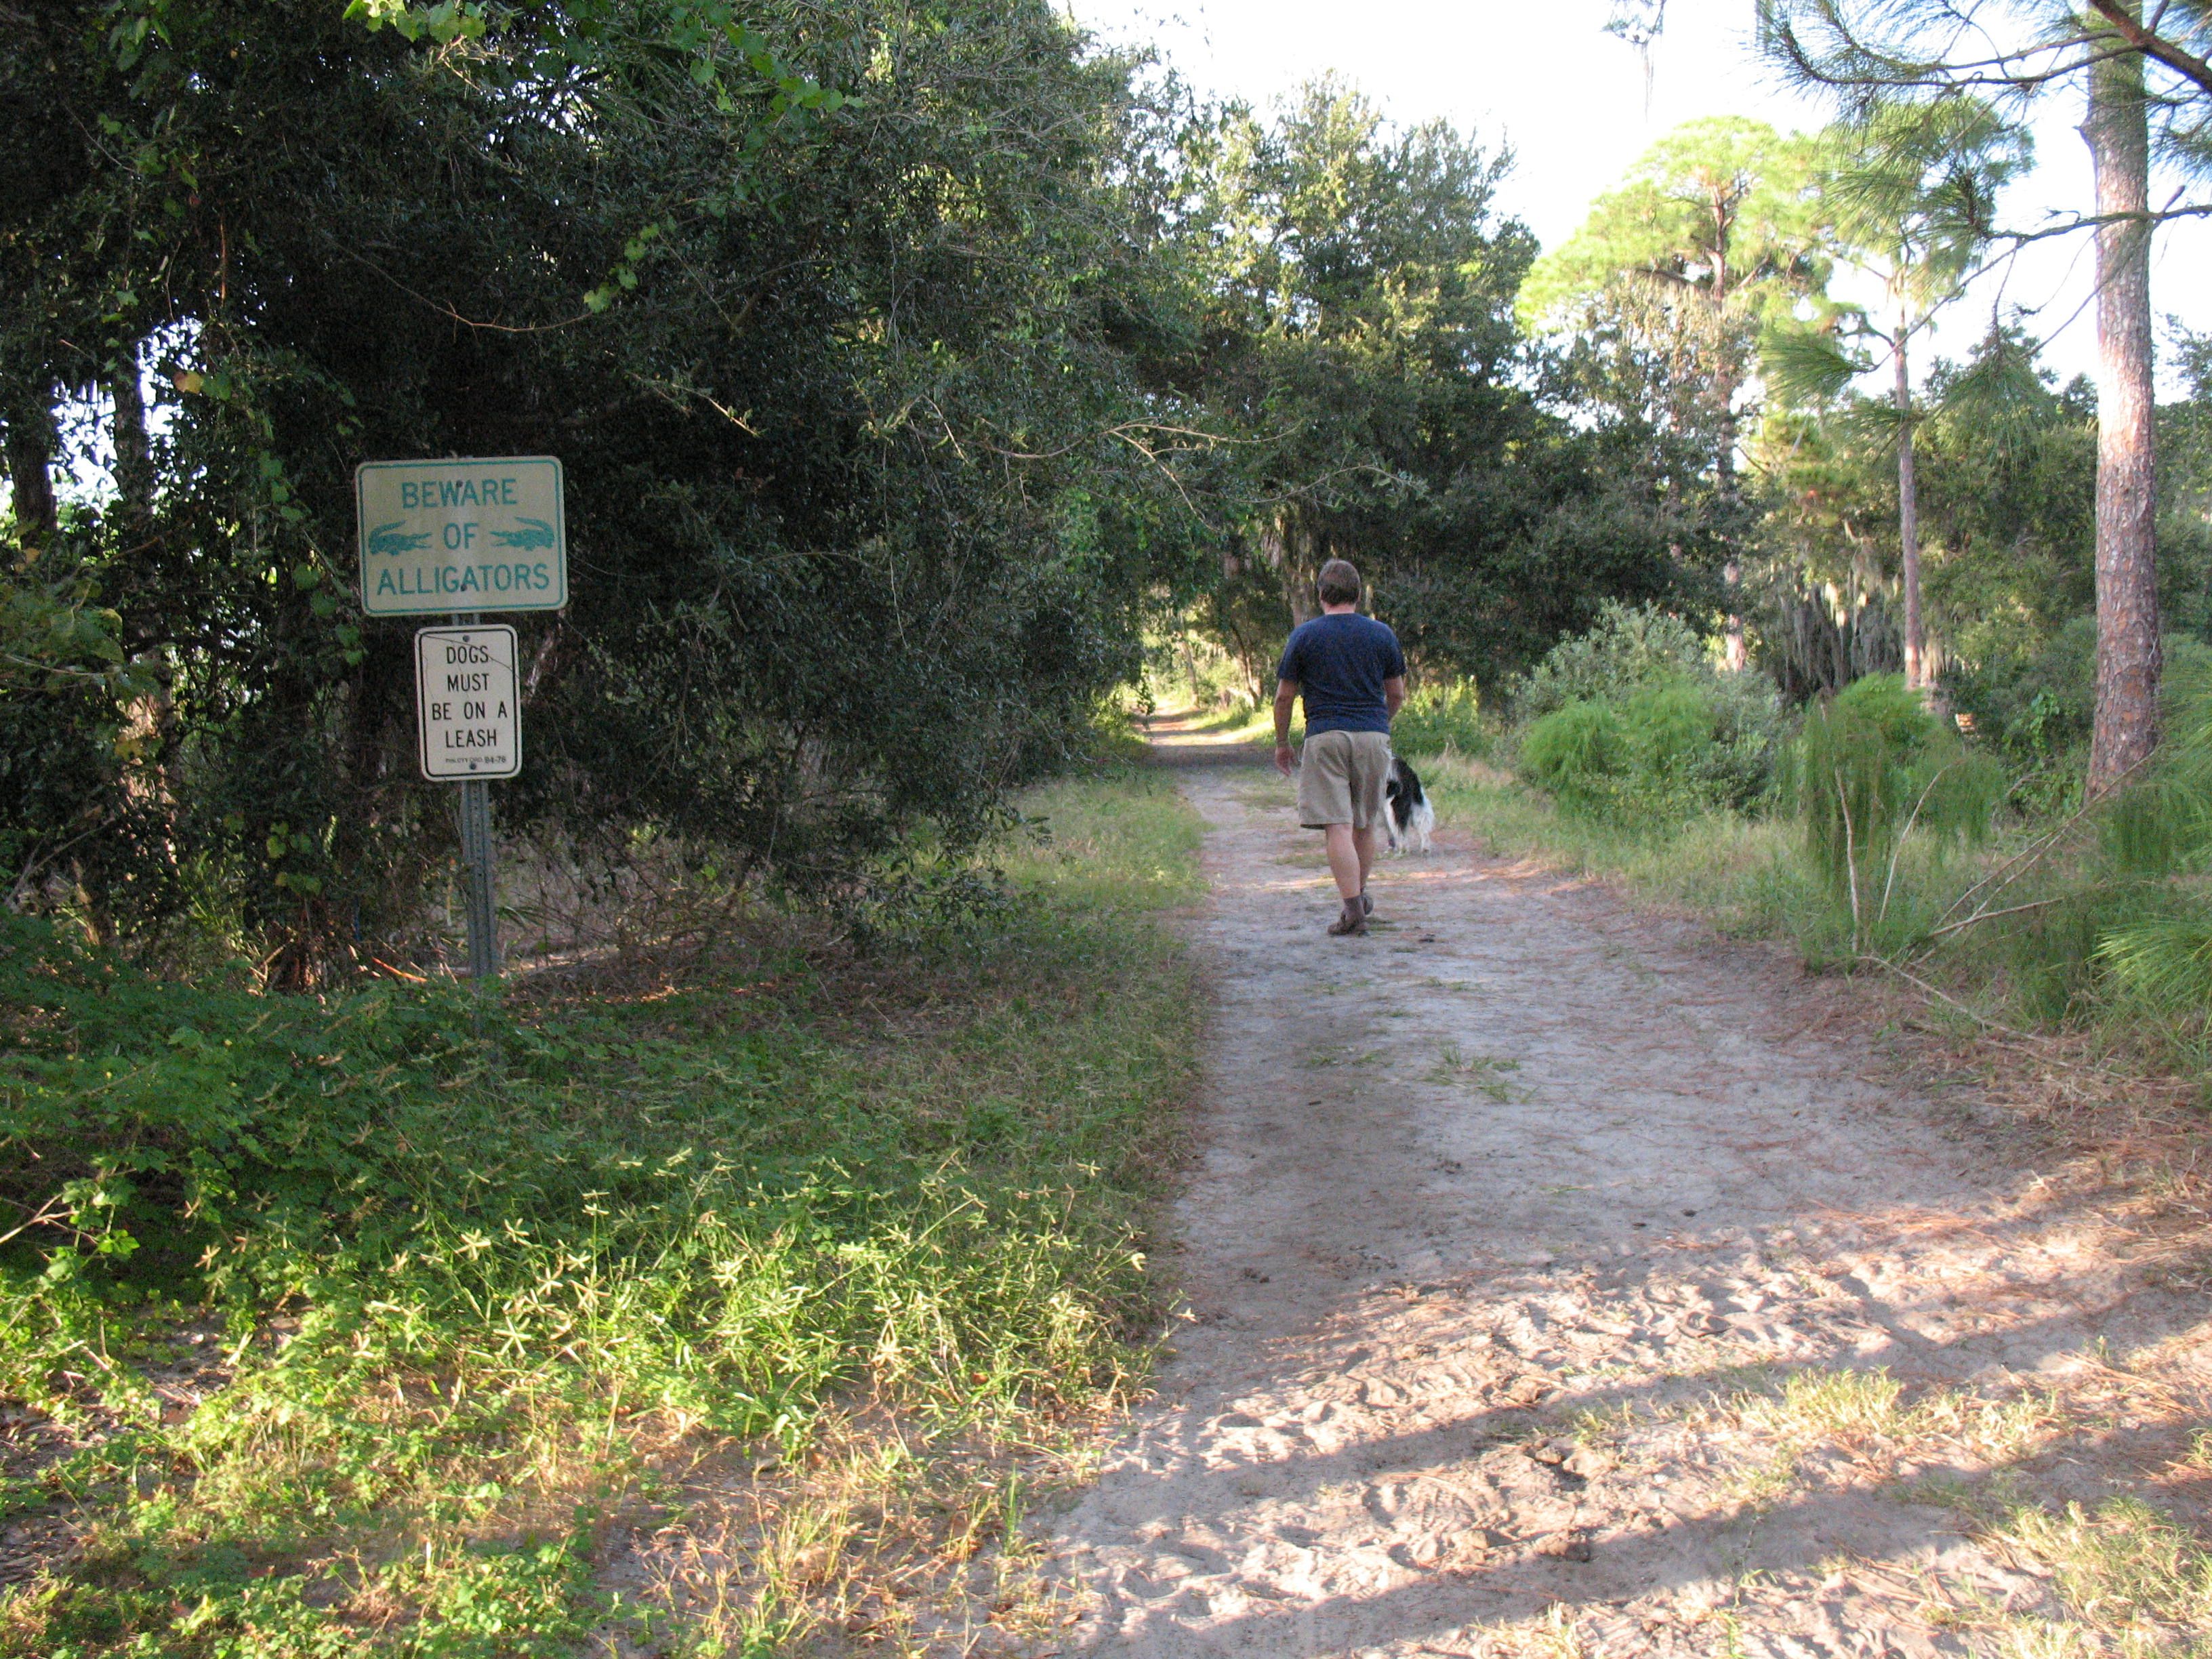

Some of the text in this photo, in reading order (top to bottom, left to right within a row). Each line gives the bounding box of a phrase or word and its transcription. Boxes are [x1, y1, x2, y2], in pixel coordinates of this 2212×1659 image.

[401, 478, 517, 509] BEWARE
[443, 522, 479, 550] OF
[377, 562, 550, 596] ALLIGATORS
[446, 646, 489, 664] DOGS
[447, 673, 489, 692] MUST
[432, 701, 508, 720] BE ON A
[445, 729, 497, 748] LEASH
